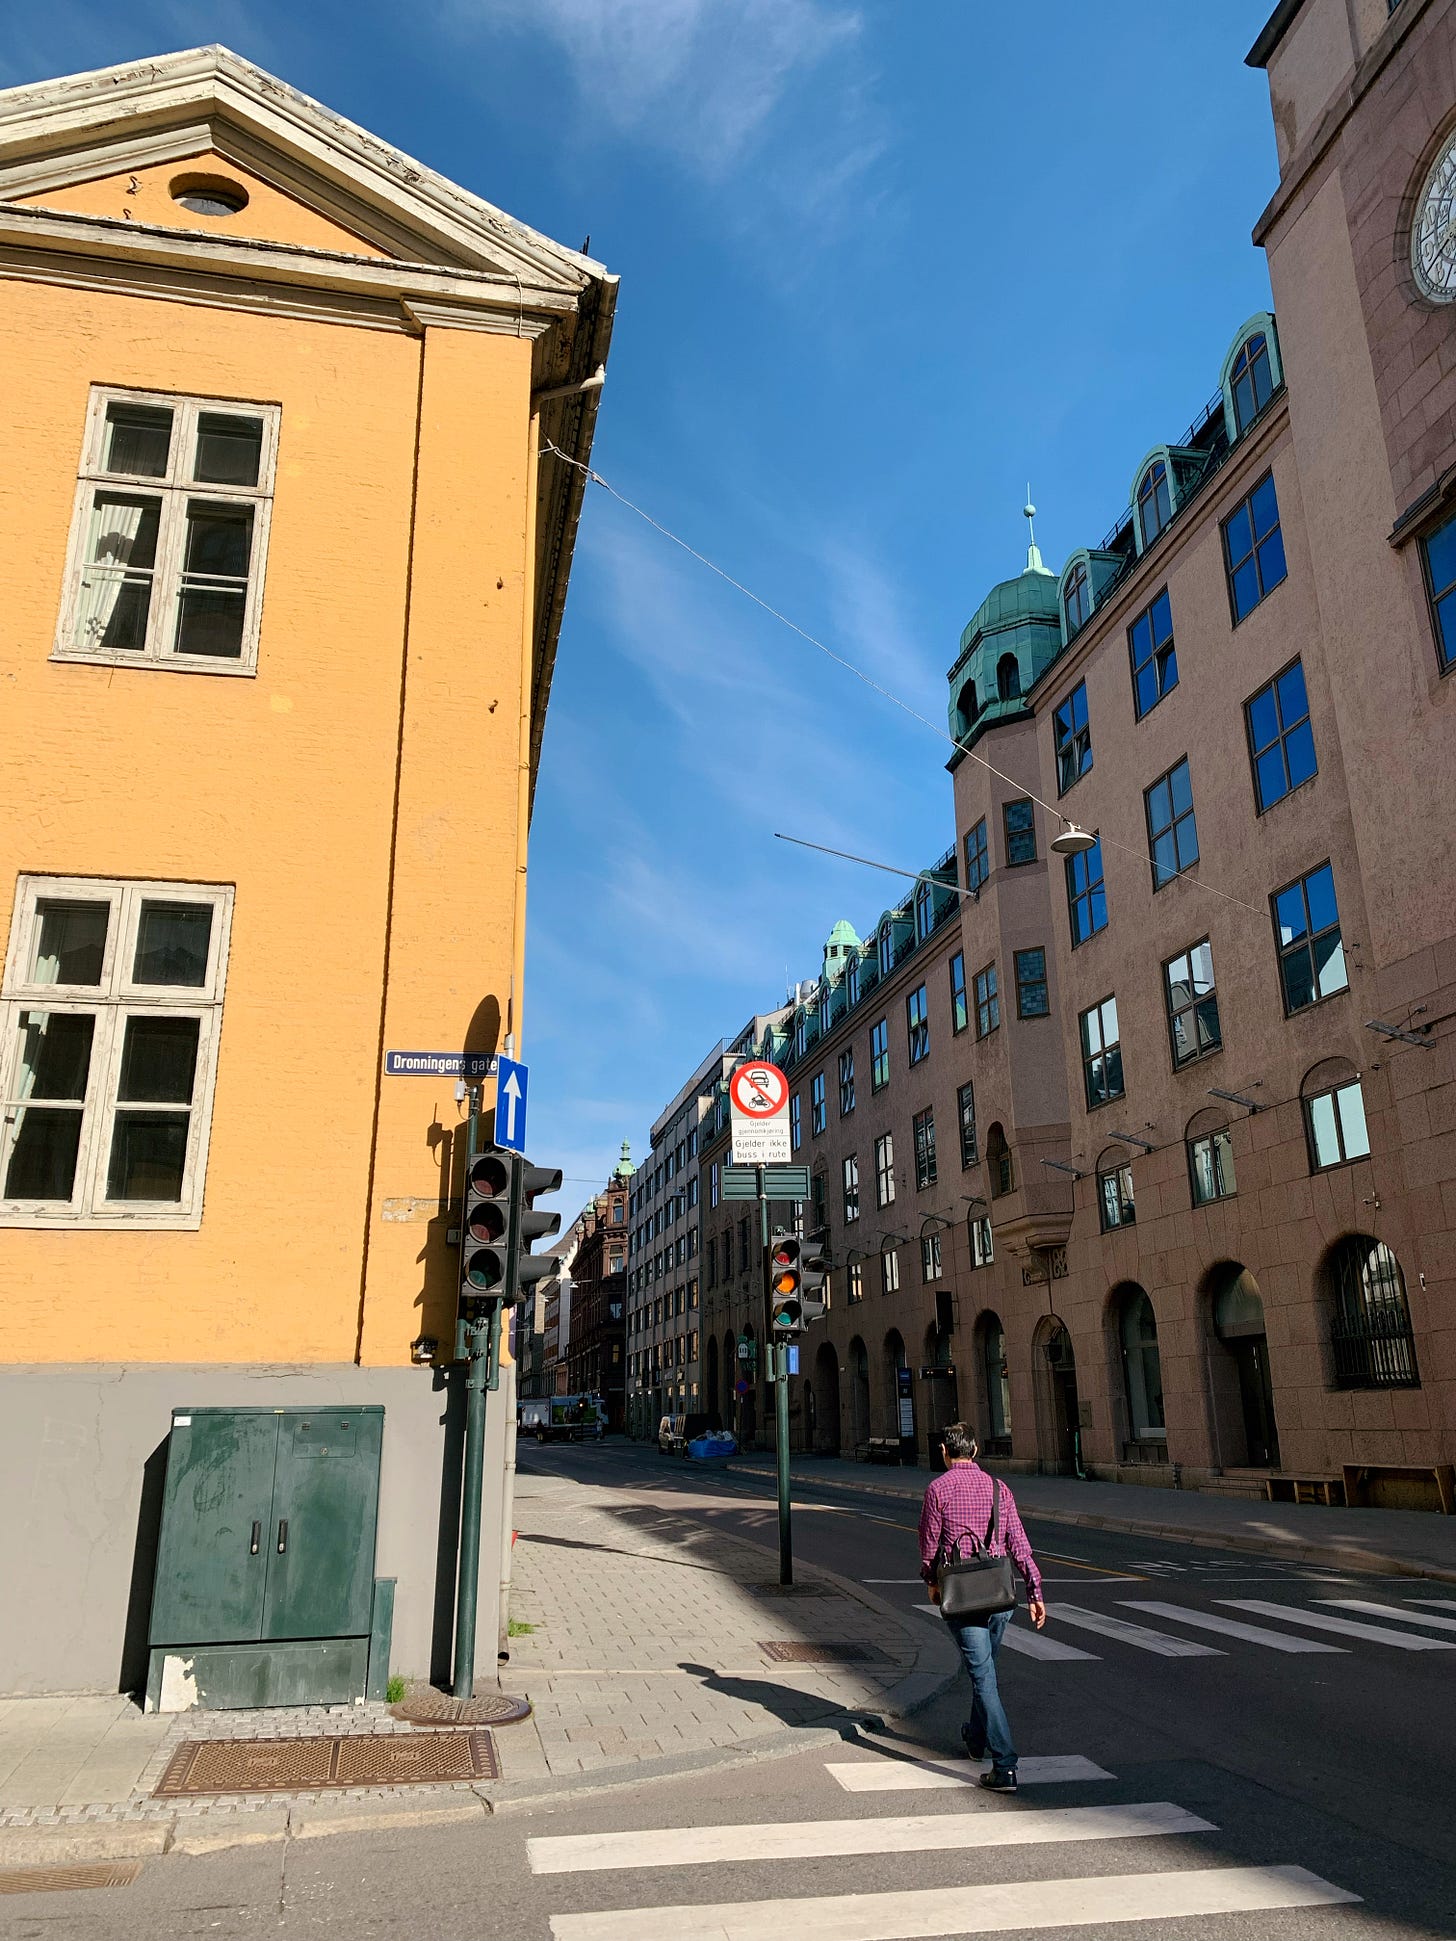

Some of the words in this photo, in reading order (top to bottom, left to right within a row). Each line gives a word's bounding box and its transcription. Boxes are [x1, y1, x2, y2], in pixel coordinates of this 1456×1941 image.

[393, 1055, 466, 1073] Dronningens
[471, 1058, 498, 1073] gate
[735, 1139, 766, 1149] Gjelder
[769, 1139, 787, 1147] ikke
[737, 1150, 758, 1158] buss
[768, 1150, 787, 1158] rute
